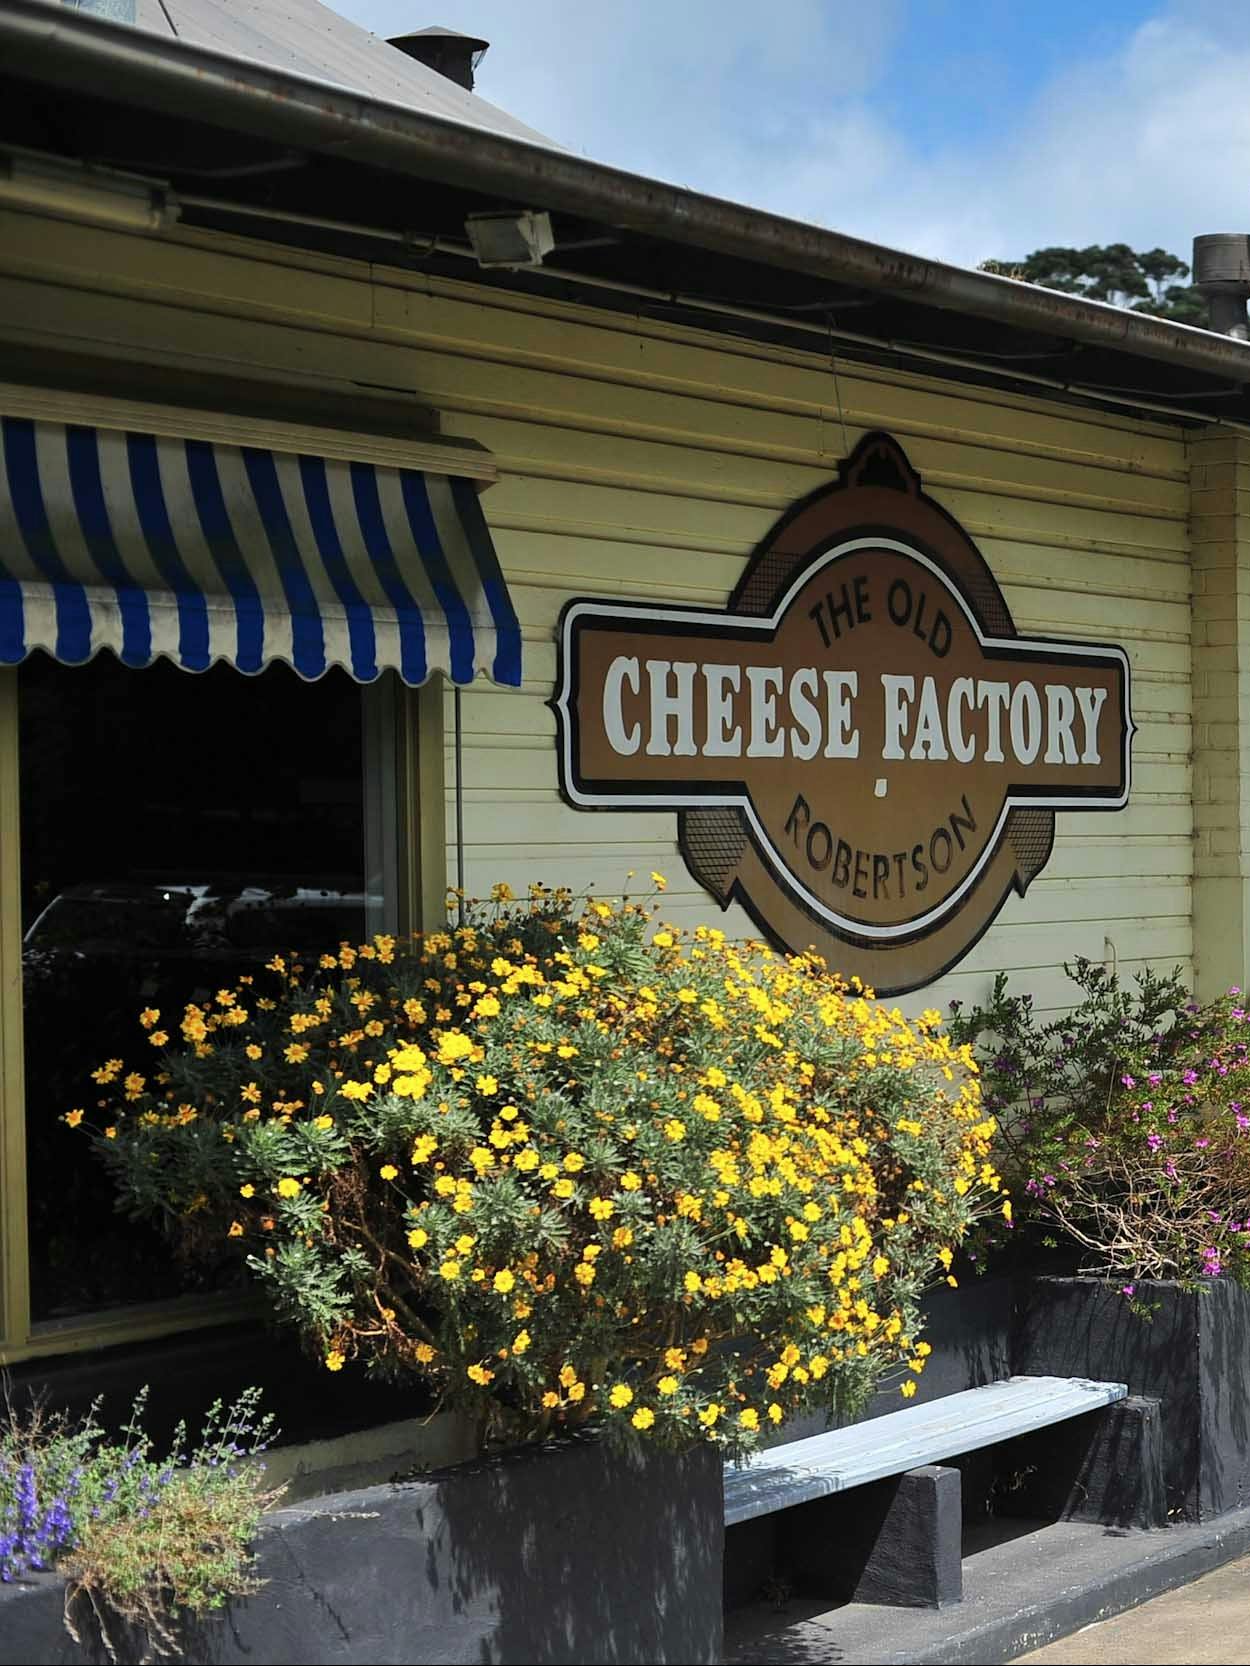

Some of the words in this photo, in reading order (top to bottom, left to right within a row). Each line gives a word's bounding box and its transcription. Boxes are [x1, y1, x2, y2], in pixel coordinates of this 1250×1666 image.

[809, 575, 872, 648] THE
[887, 578, 953, 658] OLD
[602, 655, 860, 761] CHEESE
[880, 673, 1108, 766] FACTORY
[784, 794, 978, 900] ROBERTSON
